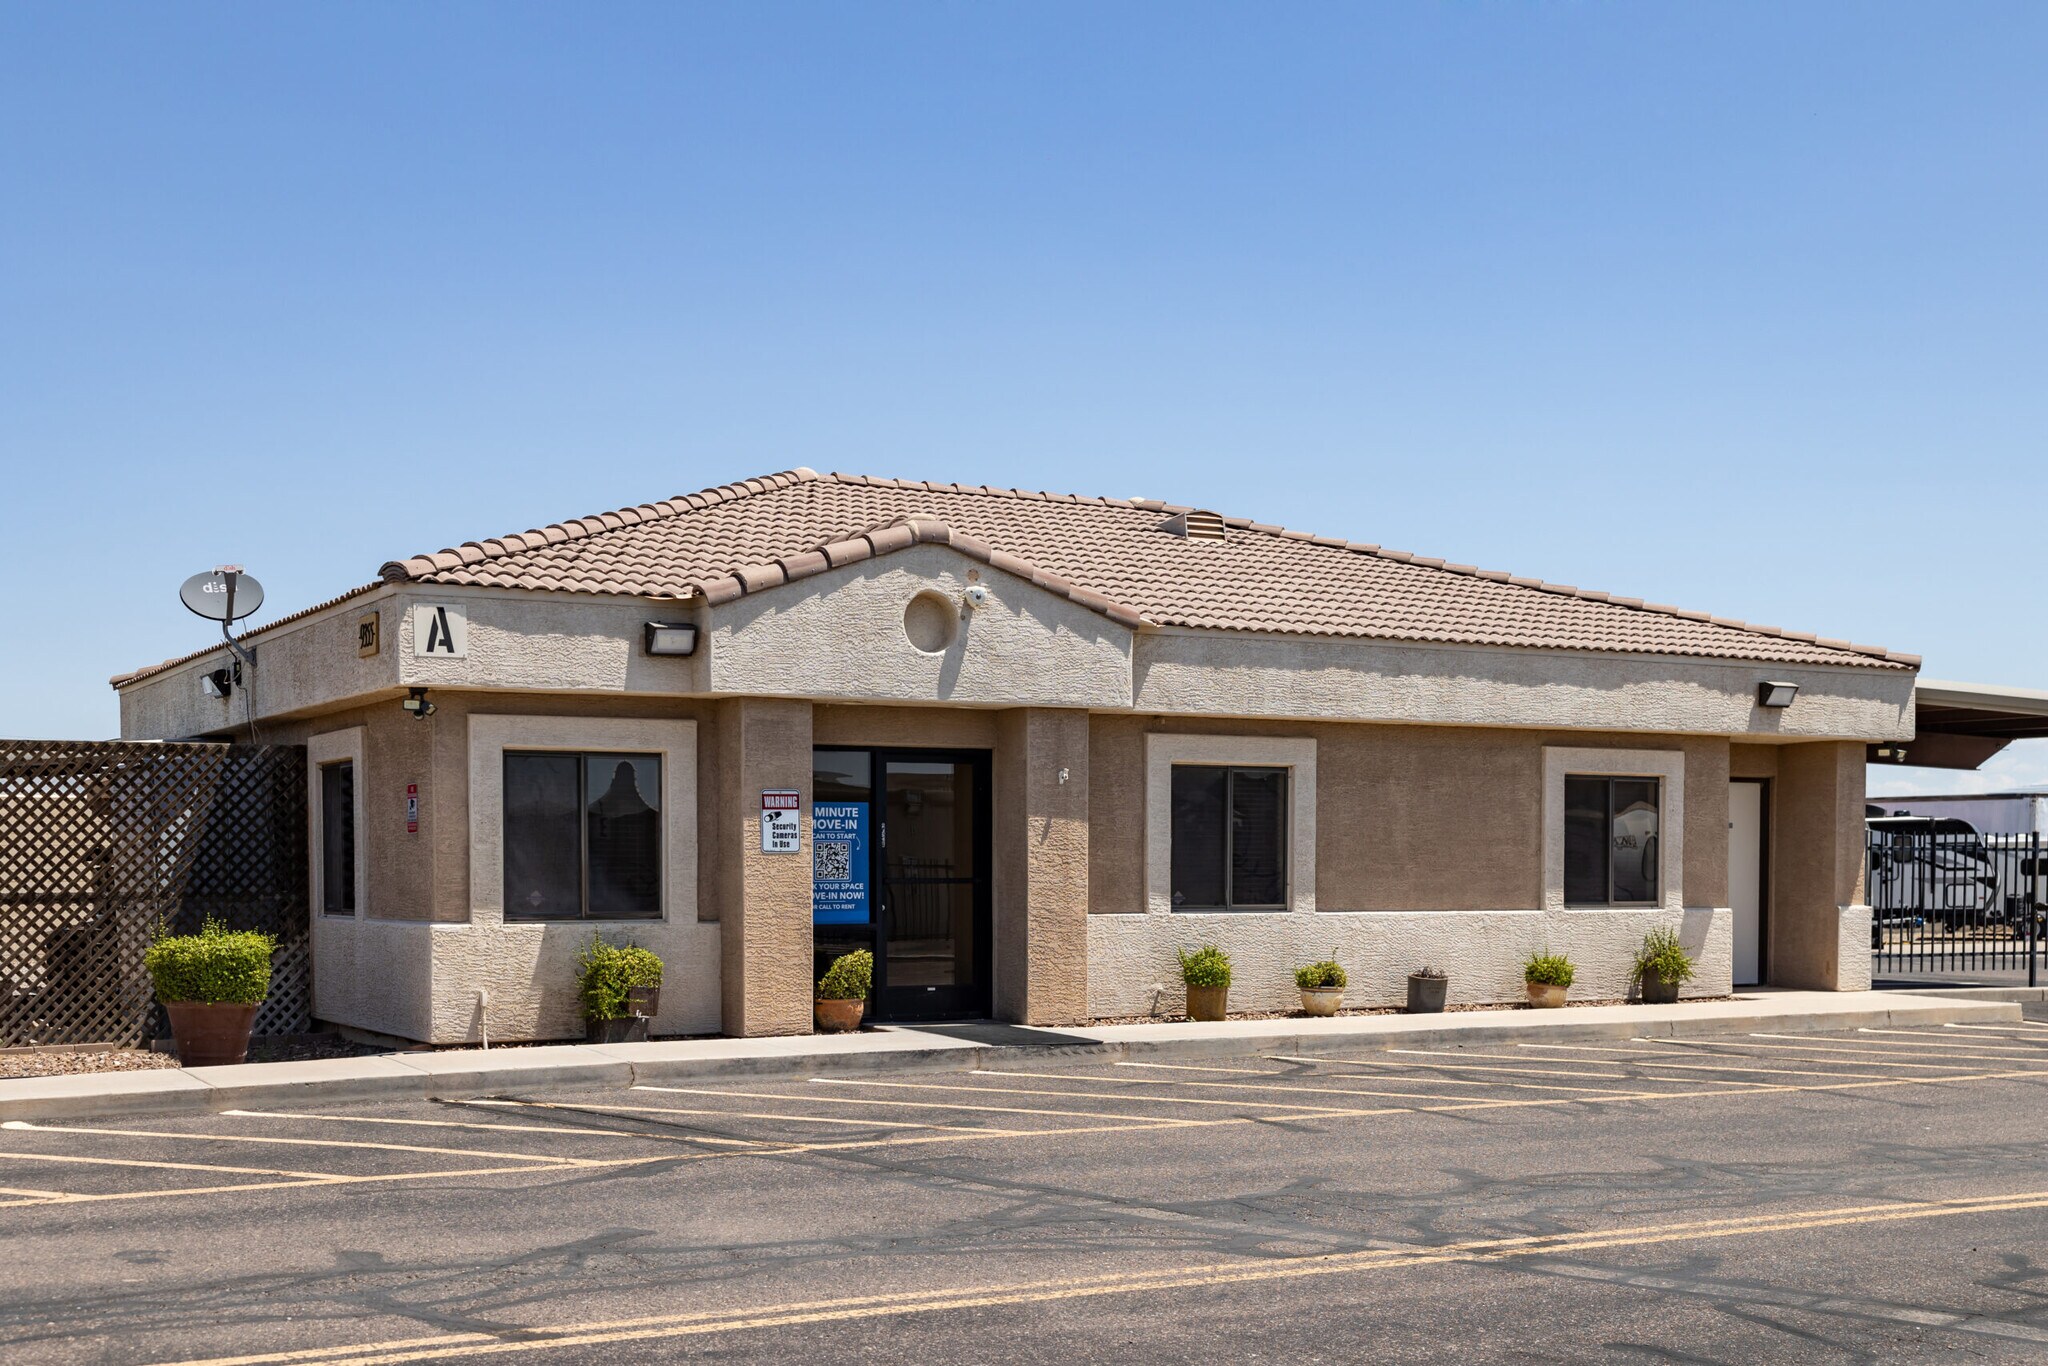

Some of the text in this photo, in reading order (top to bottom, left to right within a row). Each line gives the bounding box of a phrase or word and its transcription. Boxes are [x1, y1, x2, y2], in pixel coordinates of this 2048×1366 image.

[203, 582, 238, 593] dis
[426, 607, 455, 653] A
[764, 796, 798, 808] WARNING
[815, 807, 859, 817] MINUTE
[772, 822, 796, 831] Security
[772, 840, 790, 848] In Use
